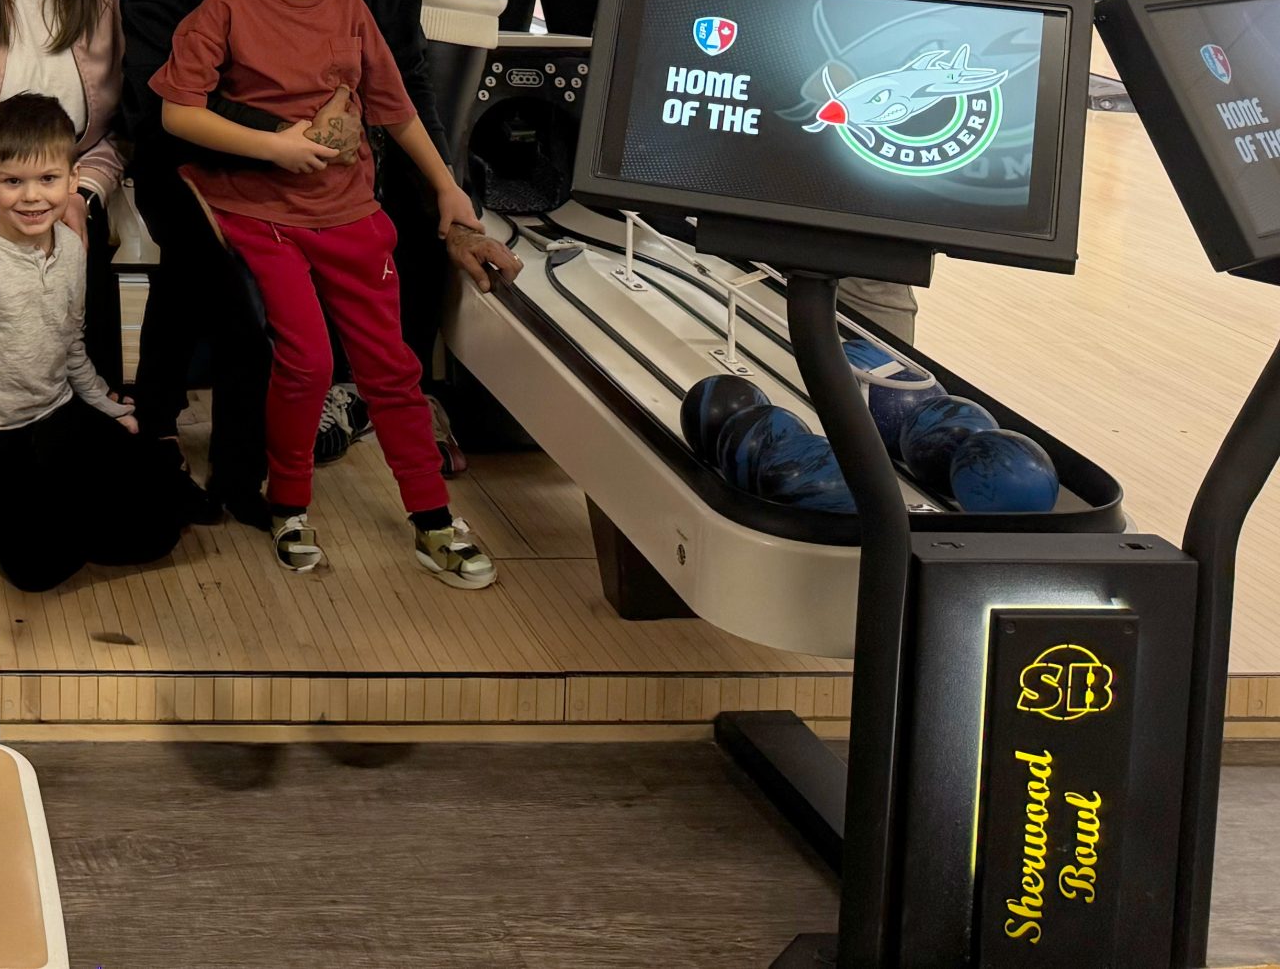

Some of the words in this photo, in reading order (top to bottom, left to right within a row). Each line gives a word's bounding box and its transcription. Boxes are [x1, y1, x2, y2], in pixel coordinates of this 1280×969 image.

[511, 74, 540, 85] 2000
[666, 66, 751, 101] HOME
[662, 98, 700, 126] OF
[707, 103, 761, 135] THE
[879, 98, 987, 163] BOMBERS
[1216, 97, 1269, 130] HOME
[1234, 134, 1259, 164] OF
[1255, 128, 1280, 159] TH
[1017, 662, 1113, 712] SB
[1004, 749, 1053, 945] Sherwood
[1058, 790, 1101, 904] Bowl
